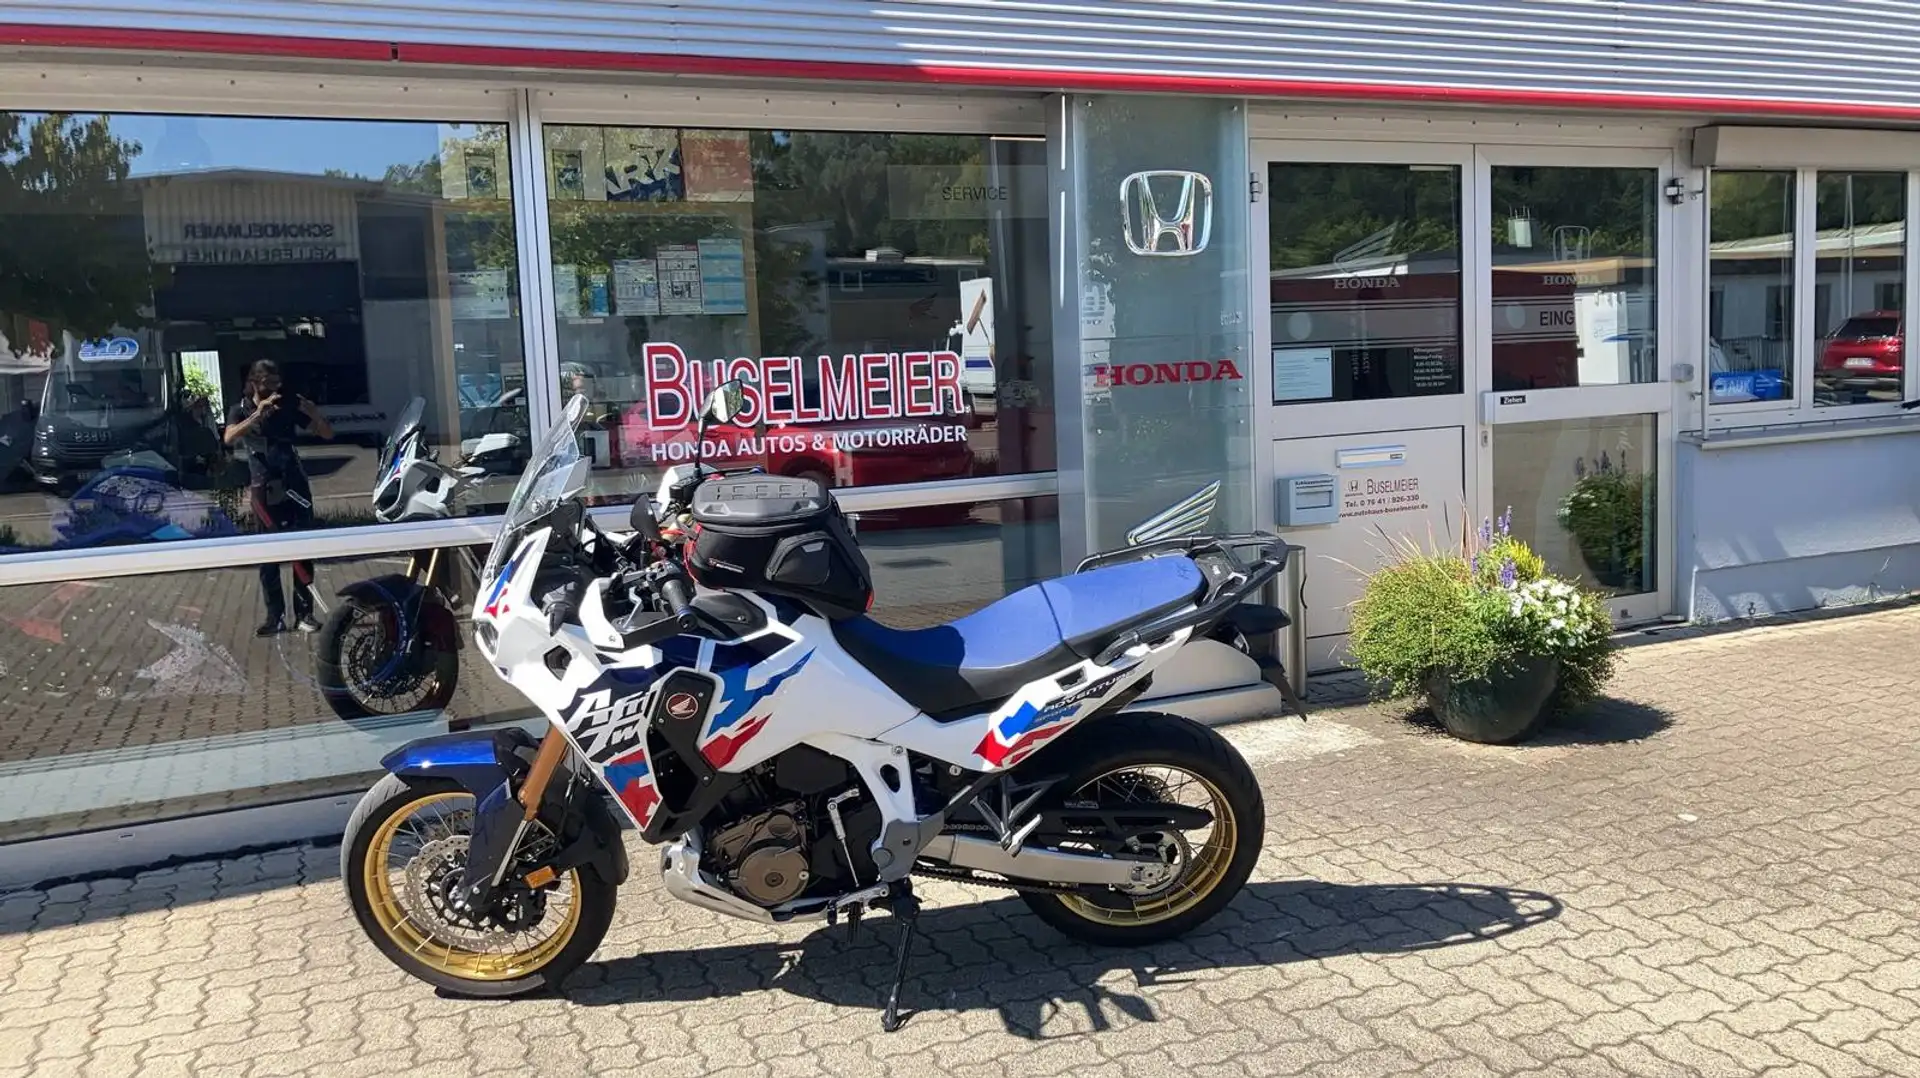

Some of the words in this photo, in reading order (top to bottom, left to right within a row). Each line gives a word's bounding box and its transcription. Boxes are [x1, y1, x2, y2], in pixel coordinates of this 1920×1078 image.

[942, 186, 1008, 200] SERVICE
[1334, 277, 1400, 289] HONDA
[1543, 275, 1600, 285] HONDA
[1540, 310, 1575, 326] EING
[1094, 360, 1243, 387] HONDA
[651, 440, 731, 462] HONDA
[737, 435, 807, 455] AUTOS
[812, 434, 826, 450] &
[832, 423, 967, 450] MOTORRÄDER
